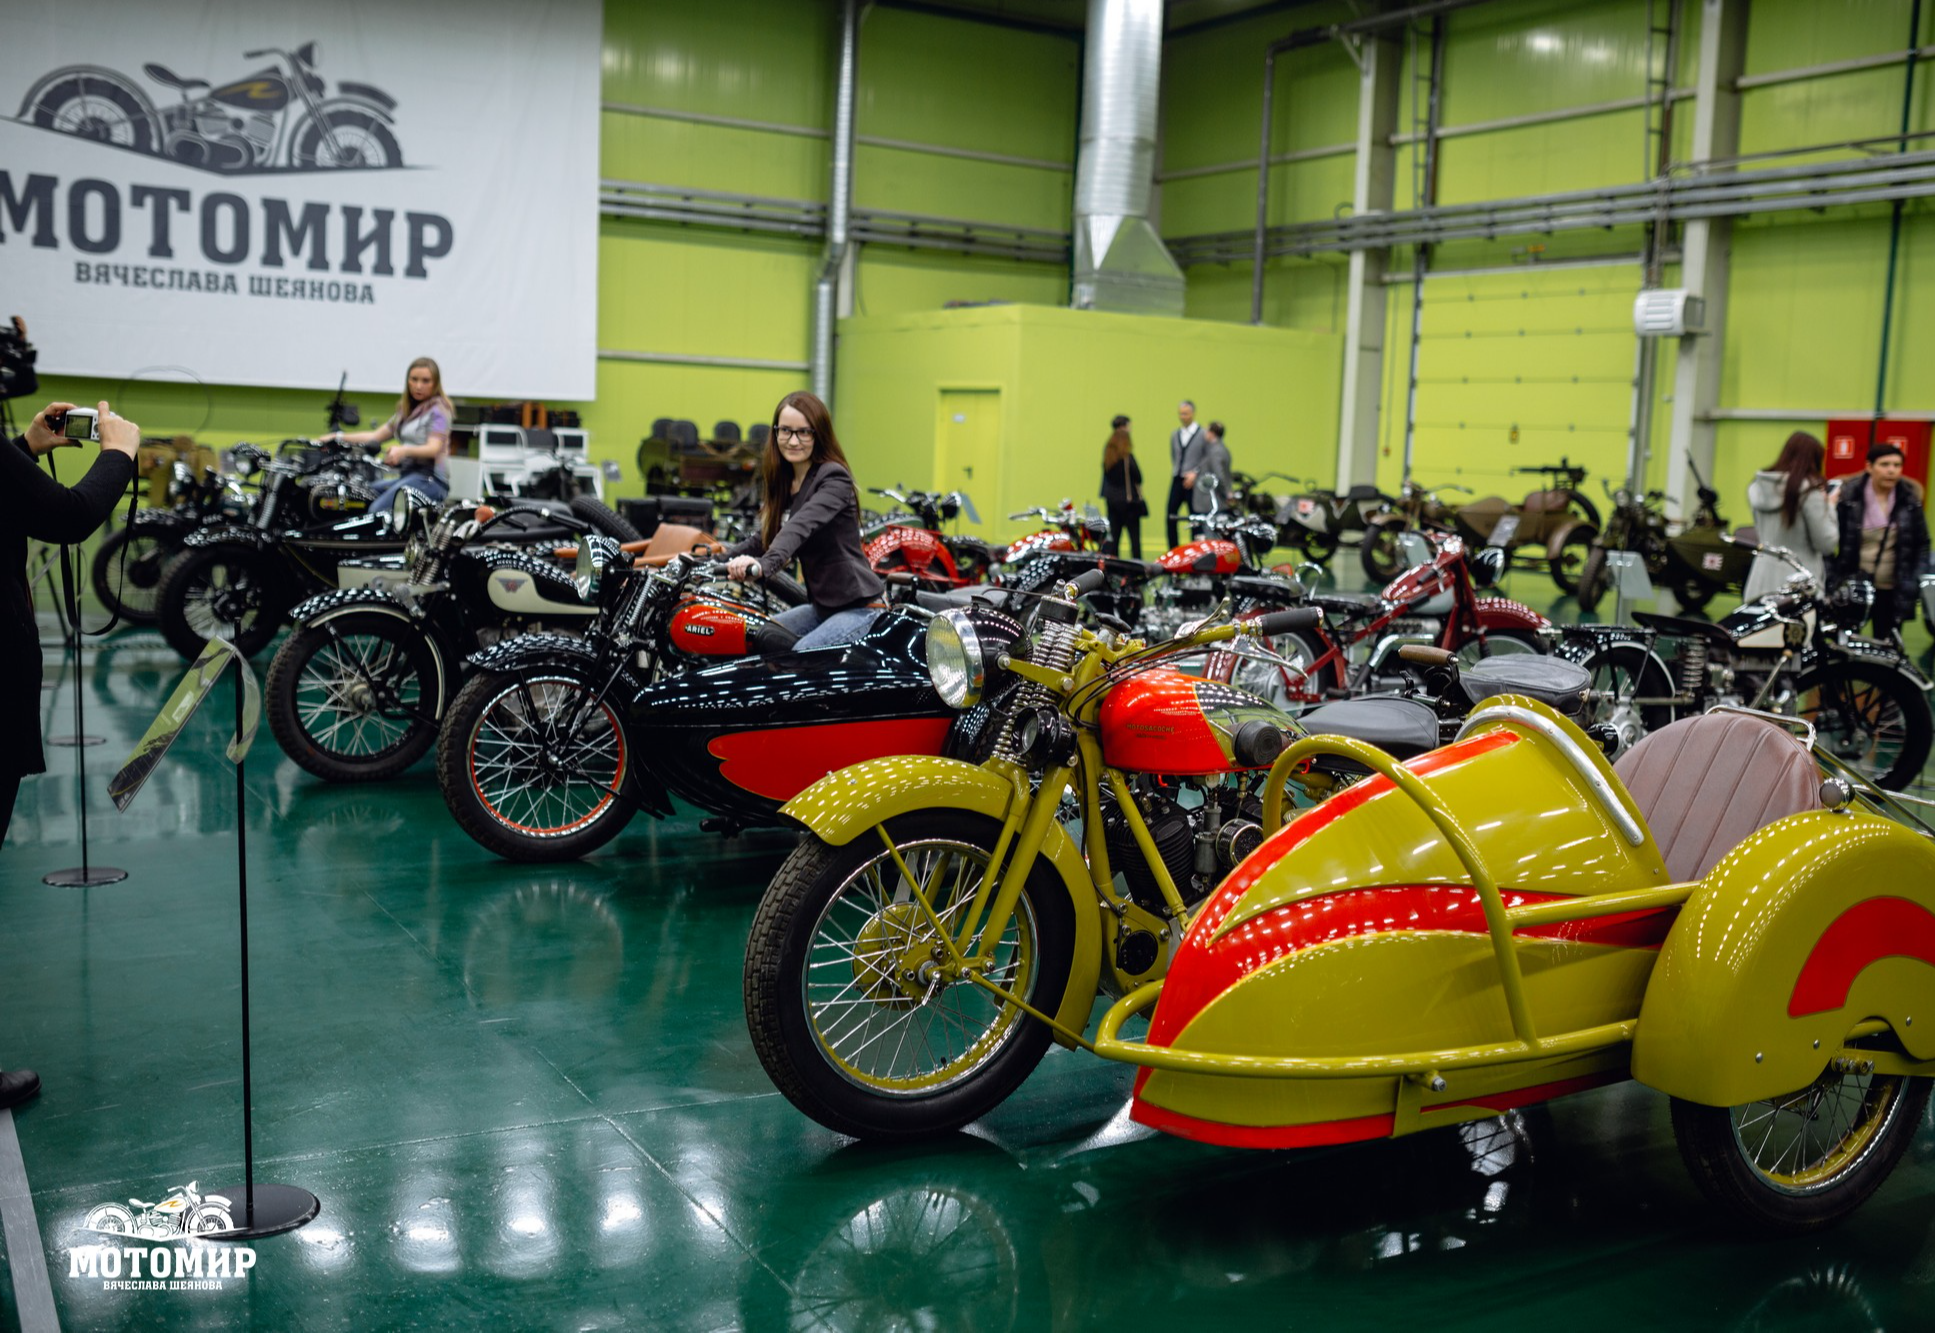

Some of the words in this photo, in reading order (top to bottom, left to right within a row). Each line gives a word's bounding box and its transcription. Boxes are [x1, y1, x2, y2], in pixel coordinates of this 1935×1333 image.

[0, 168, 454, 280] МОТОМИР
[75, 261, 238, 296] ВЯЧЕСЛАВА
[248, 275, 376, 305] ШЕЯНОВА
[687, 625, 711, 635] ARIEL
